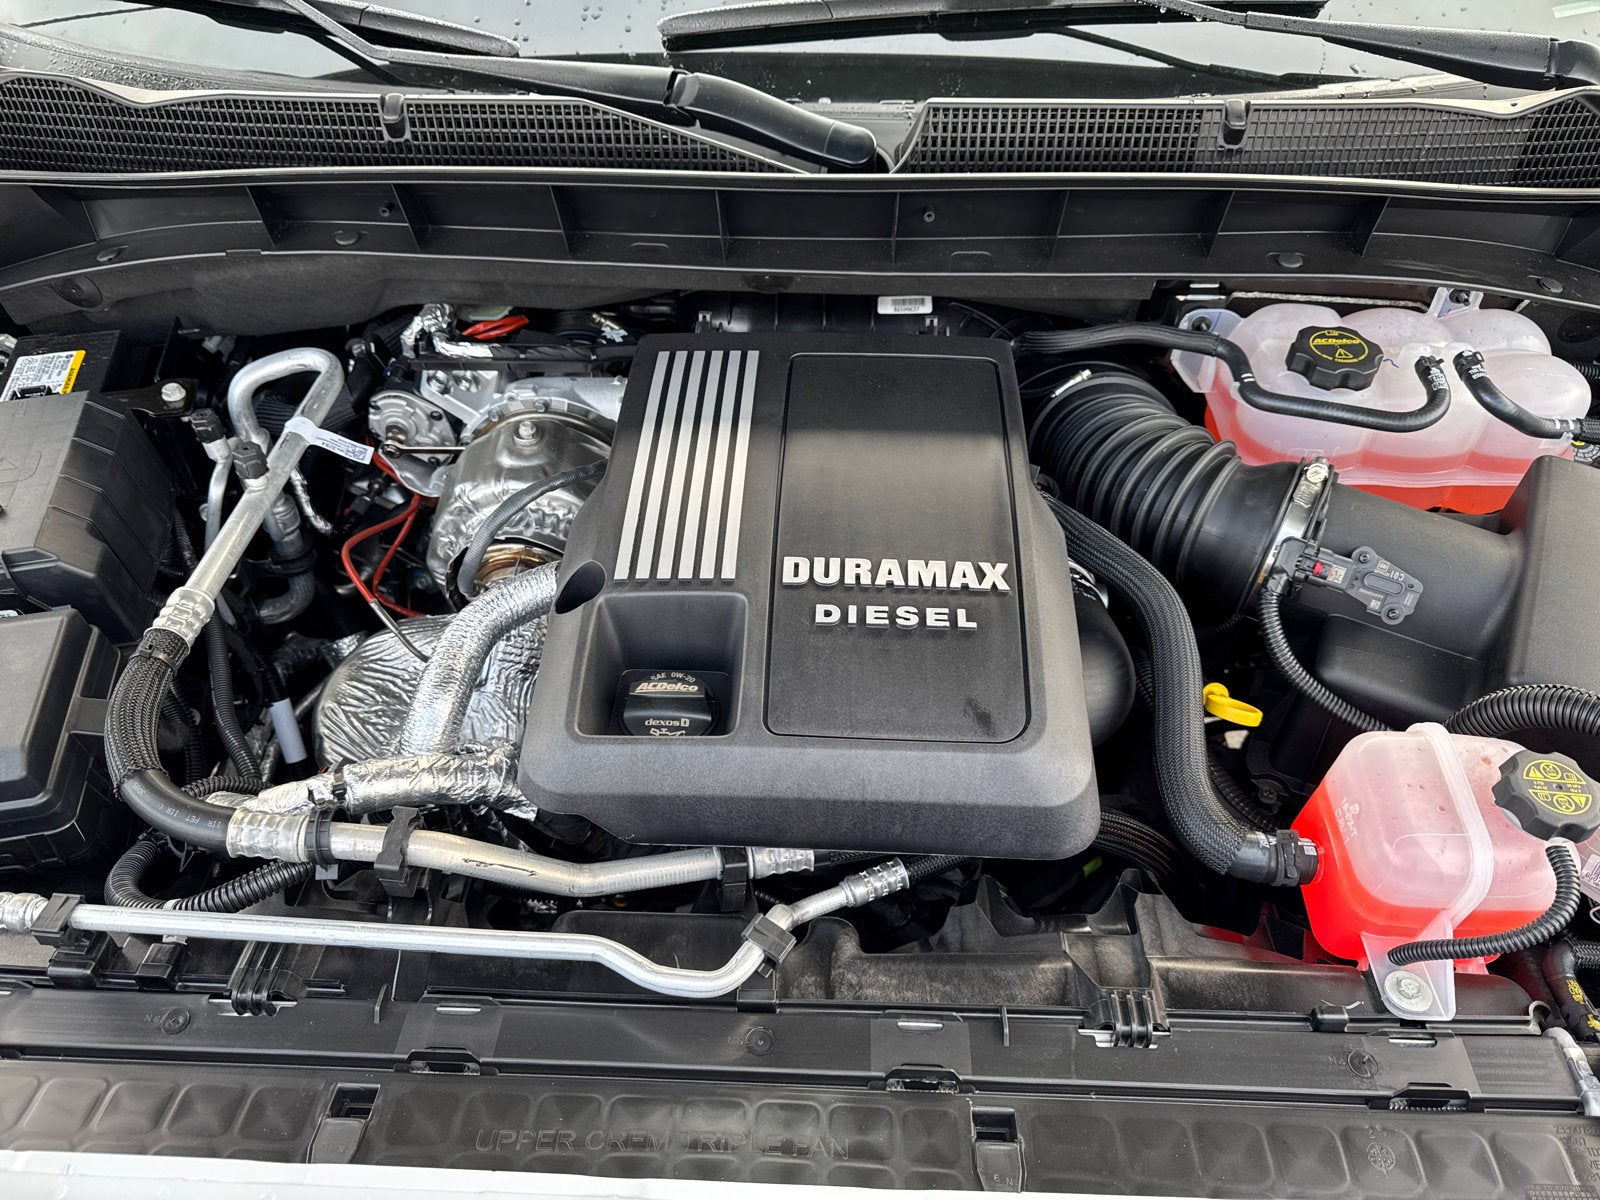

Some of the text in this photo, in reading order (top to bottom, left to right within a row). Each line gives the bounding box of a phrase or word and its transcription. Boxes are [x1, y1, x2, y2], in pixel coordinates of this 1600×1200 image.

[782, 556, 1011, 591] DURAMAX
[815, 603, 978, 630] DIESEL
[635, 682, 699, 692] ACDelco
[650, 671, 696, 683] SAE 0W-20
[475, 1129, 849, 1160] UPPER CRFM TRIPLE FAN
